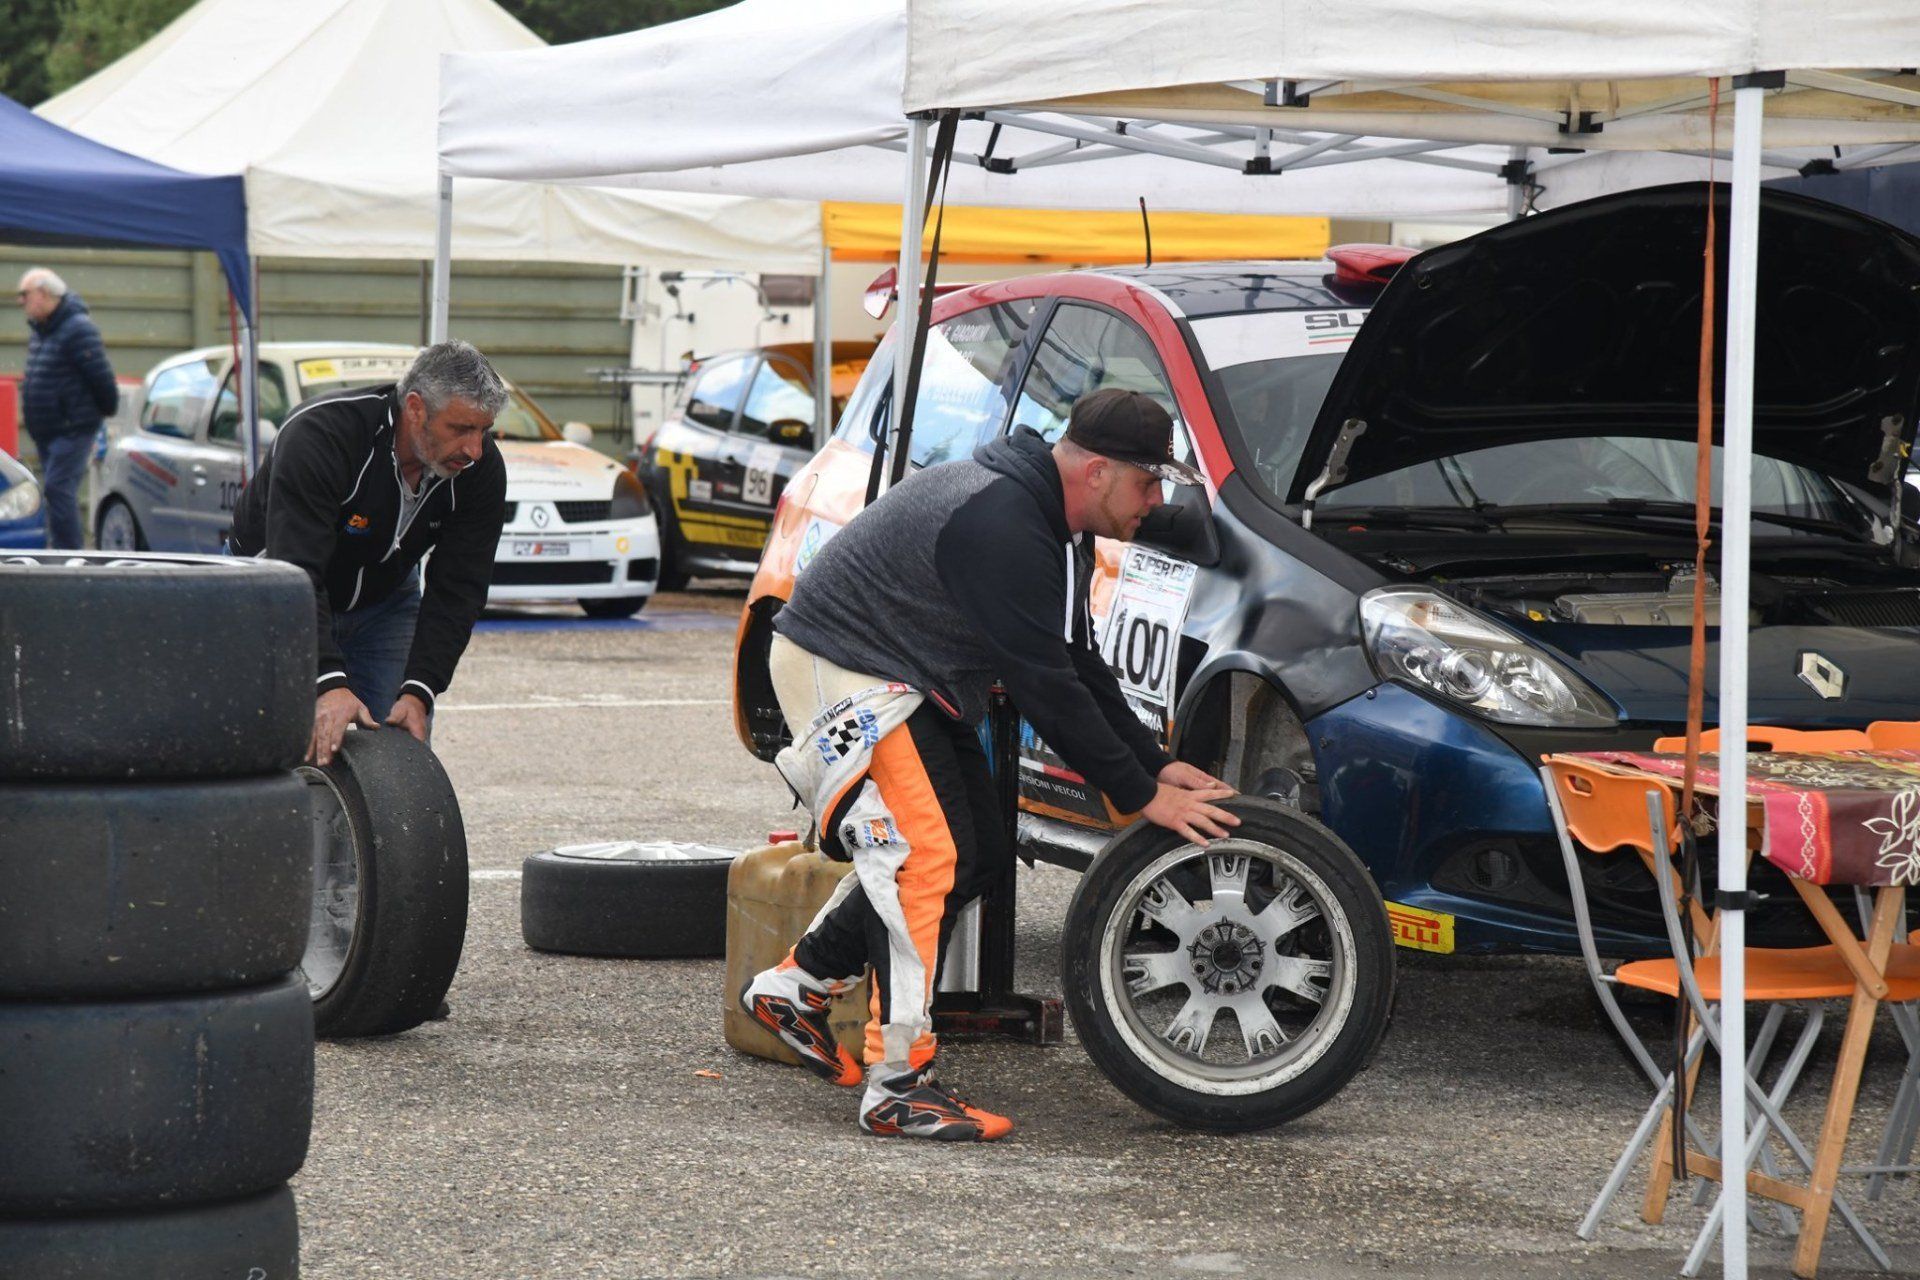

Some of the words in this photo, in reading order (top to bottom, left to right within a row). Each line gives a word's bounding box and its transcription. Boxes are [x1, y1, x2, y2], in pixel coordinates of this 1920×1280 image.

[1304, 312, 1370, 330] SU
[219, 480, 244, 510] 10
[749, 468, 768, 496] 96
[1110, 607, 1169, 692] 100
[1051, 783, 1087, 801] VEICOLI
